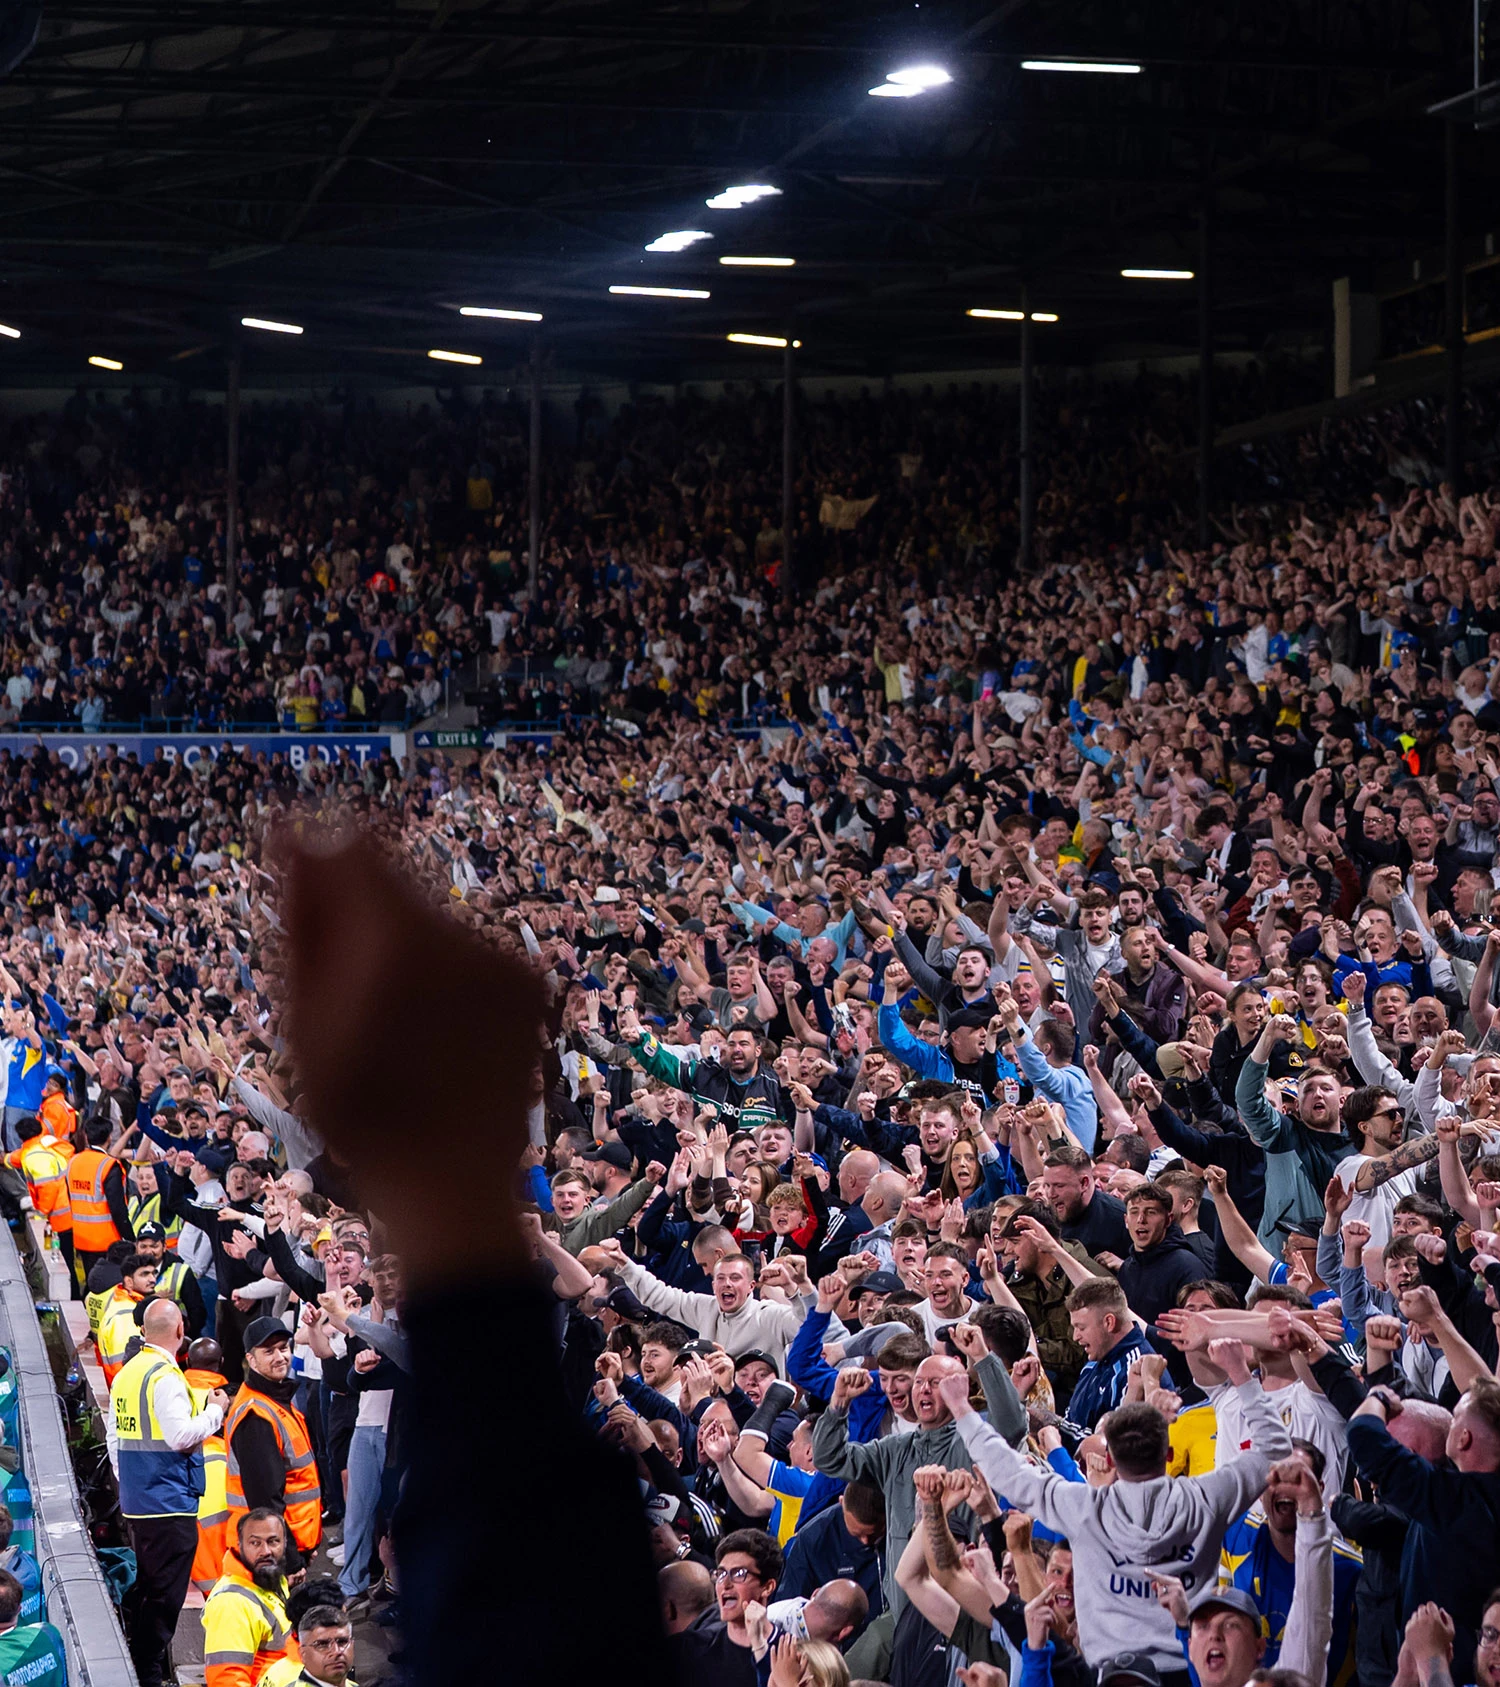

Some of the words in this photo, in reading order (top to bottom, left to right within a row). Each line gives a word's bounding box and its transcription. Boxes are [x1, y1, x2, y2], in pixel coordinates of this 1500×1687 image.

[437, 732, 461, 745] EXIT
[1110, 1571, 1195, 1598] UNID
[7, 1652, 58, 1687] PHOTOGRAPHER
